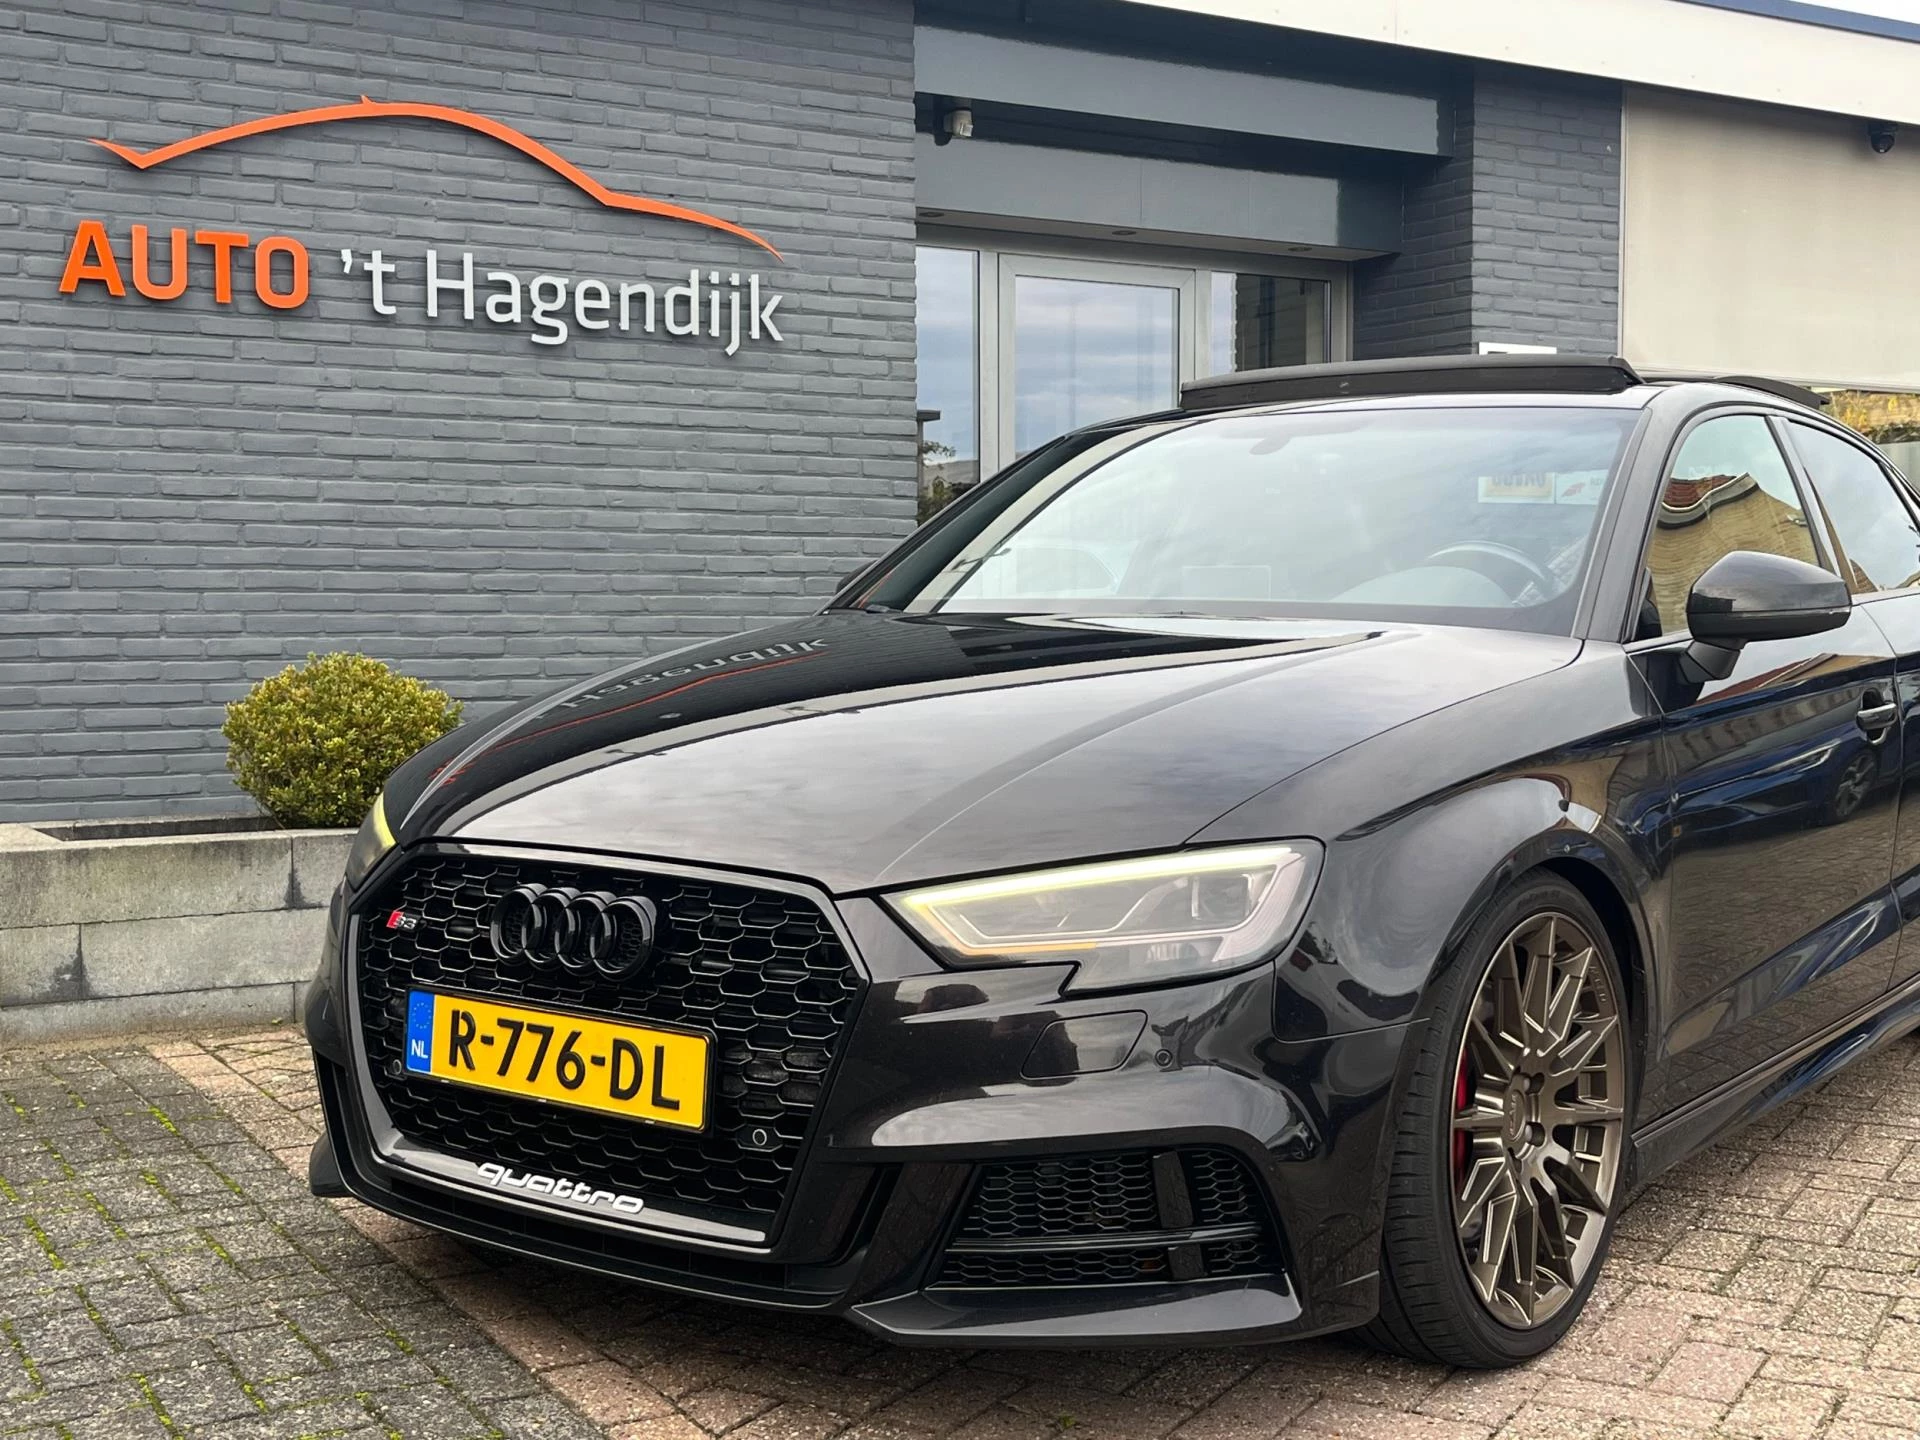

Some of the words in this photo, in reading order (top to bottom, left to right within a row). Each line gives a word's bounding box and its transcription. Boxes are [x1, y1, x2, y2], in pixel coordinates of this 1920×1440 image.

[59, 220, 310, 310] AUTO
[426, 249, 785, 357] Hagendijk
[411, 1039, 428, 1059] NL
[449, 1009, 680, 1111] R-776-DL
[476, 1162, 644, 1214] quattro
